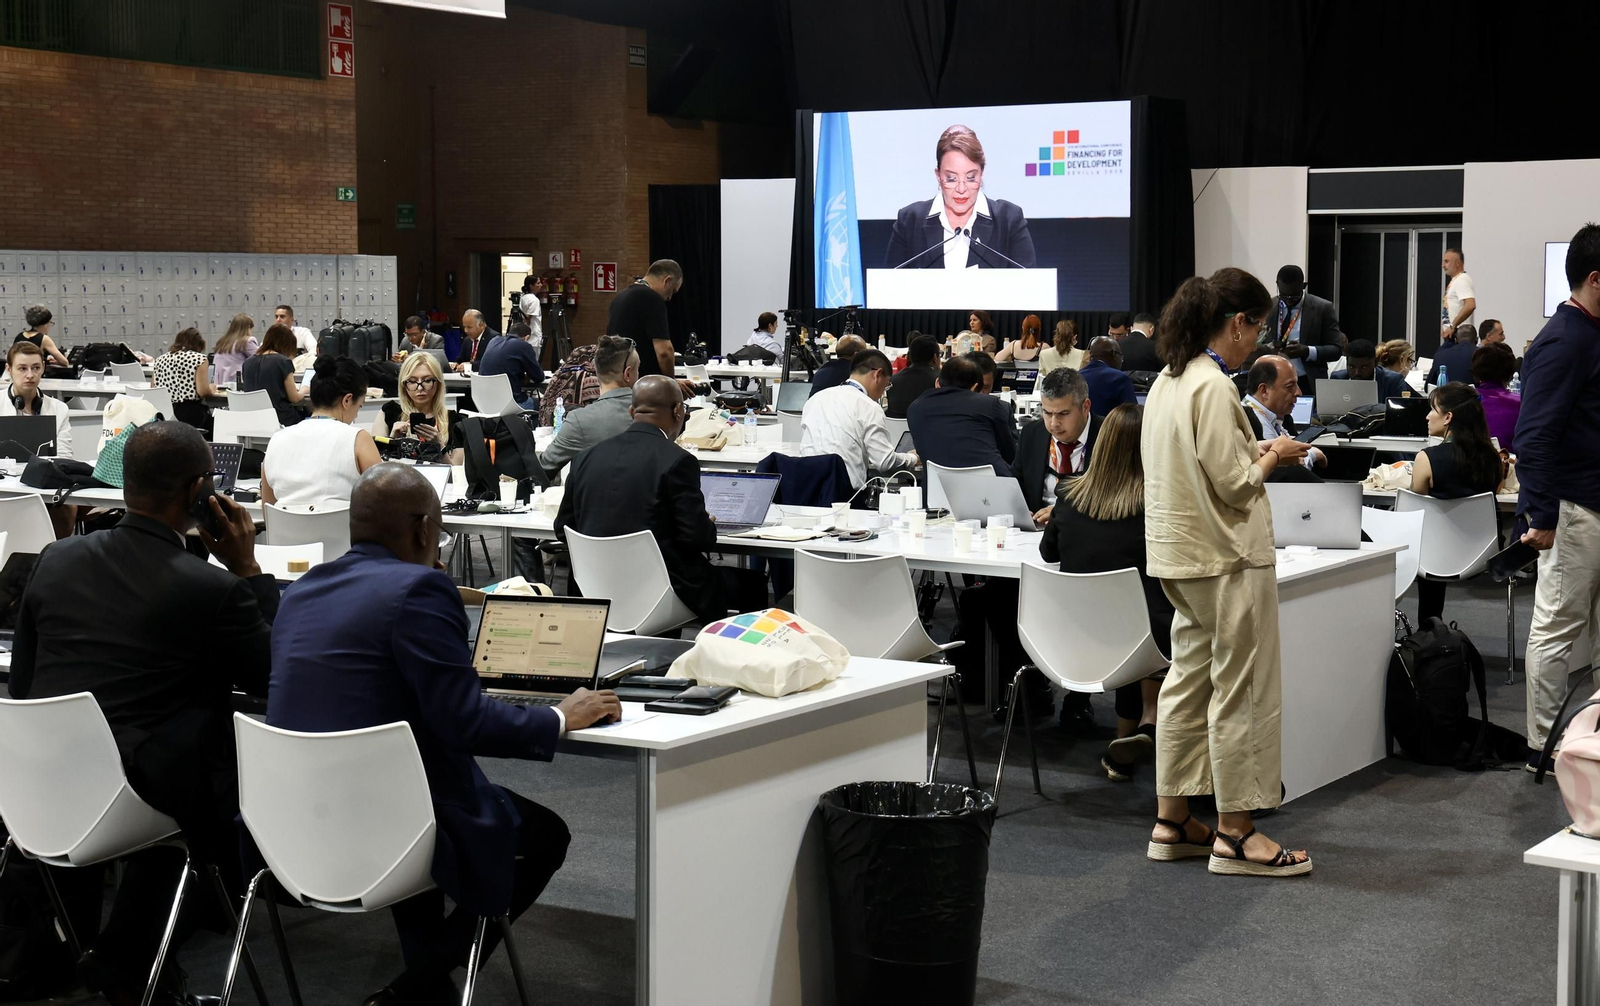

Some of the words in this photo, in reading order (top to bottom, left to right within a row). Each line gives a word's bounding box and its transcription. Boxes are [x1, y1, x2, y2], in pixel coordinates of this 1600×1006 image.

[1067, 149, 1106, 158] FINANCING
[1108, 148, 1123, 157] FOR
[1067, 159, 1122, 169] DEVELOPMENT
